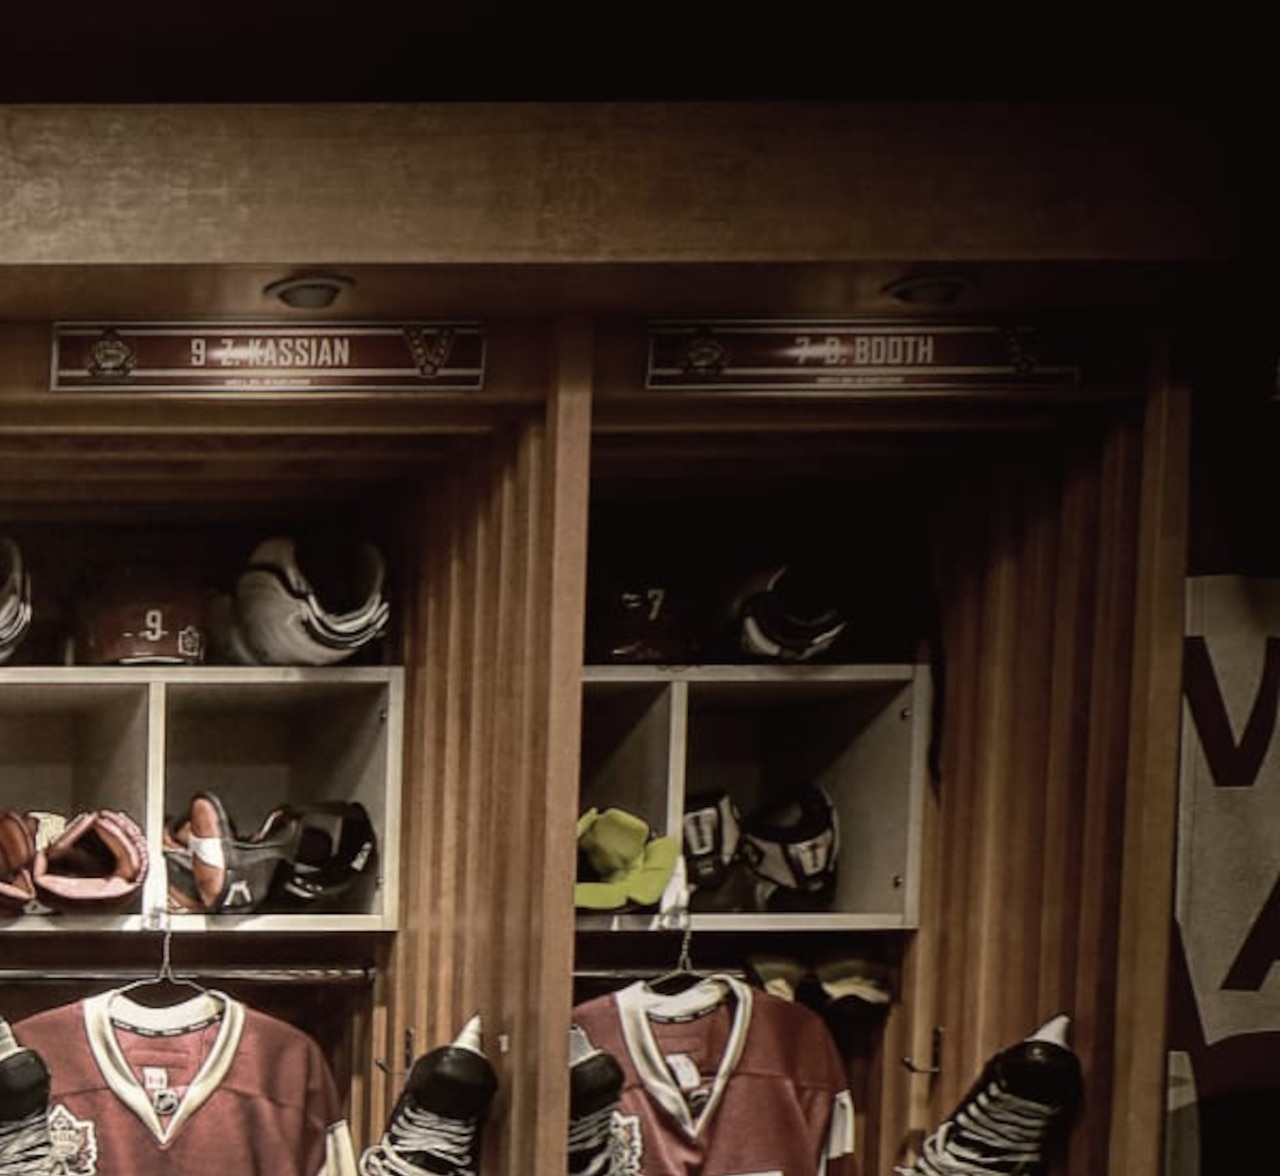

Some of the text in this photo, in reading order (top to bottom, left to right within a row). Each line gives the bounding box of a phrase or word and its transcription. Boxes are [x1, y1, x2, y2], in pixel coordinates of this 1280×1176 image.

[190, 337, 207, 367] 9
[247, 337, 351, 367] KASSIAN
[794, 335, 811, 364] 7
[853, 335, 935, 365] BOOTH
[144, 608, 162, 641] 9
